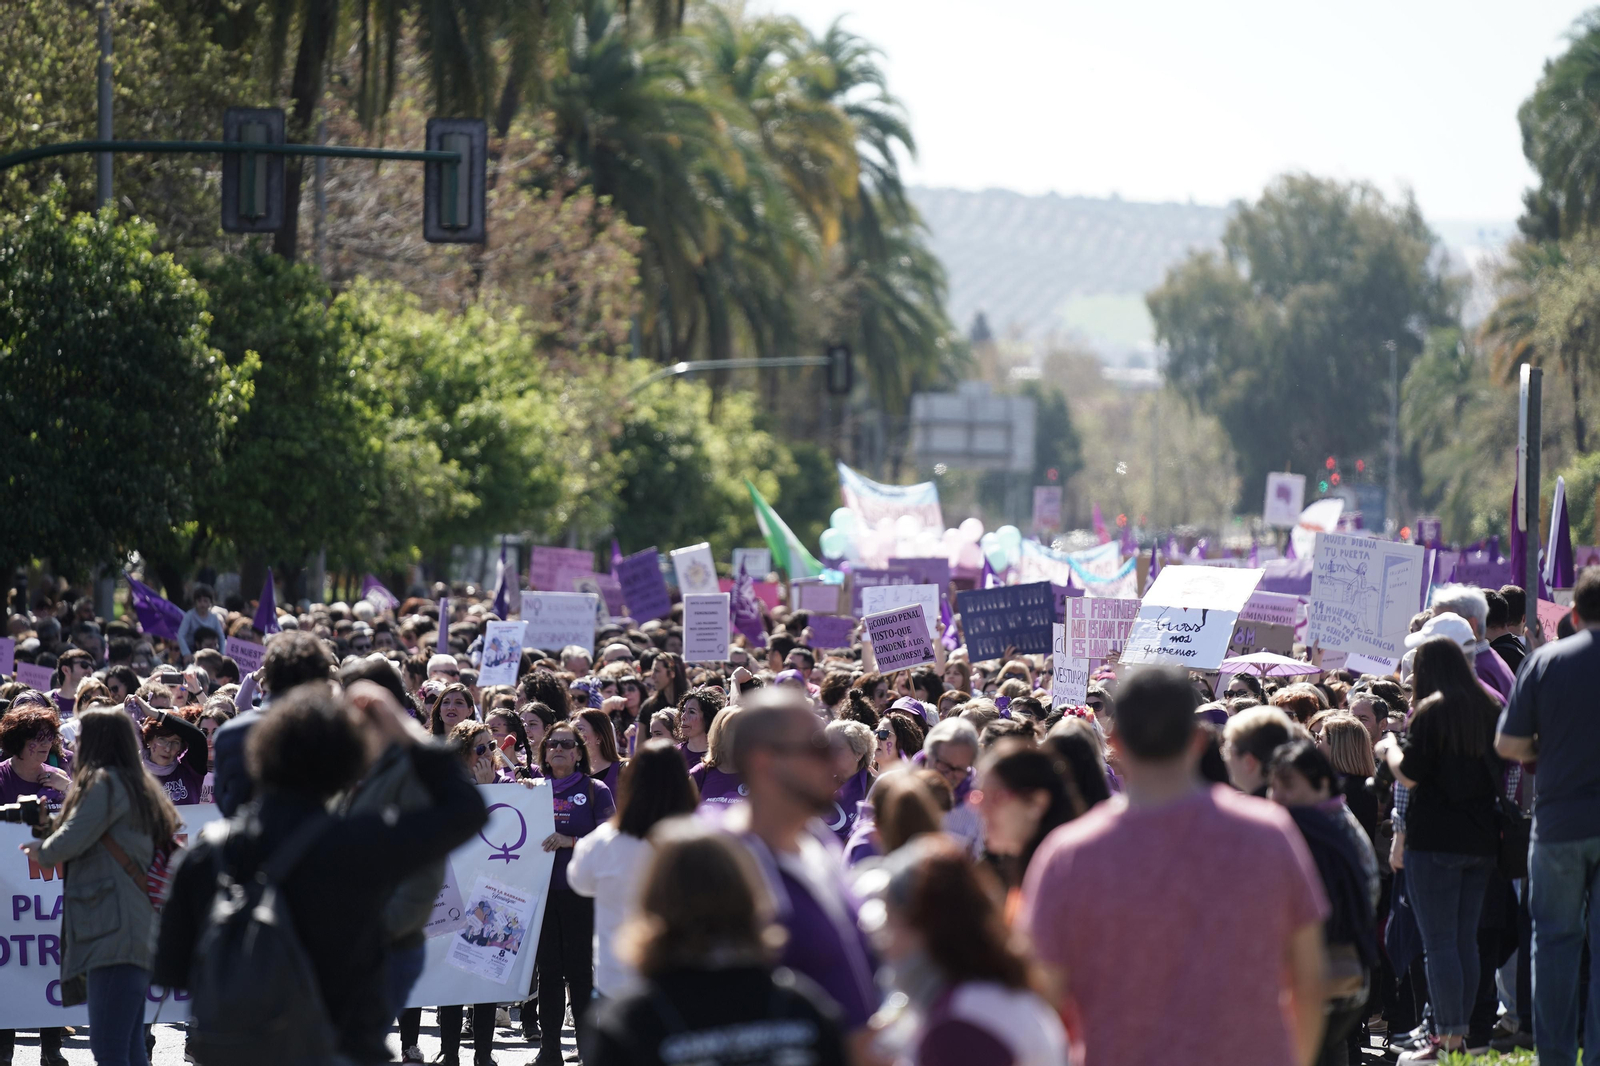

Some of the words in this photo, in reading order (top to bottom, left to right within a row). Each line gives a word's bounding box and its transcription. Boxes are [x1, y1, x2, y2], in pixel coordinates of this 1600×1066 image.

[1323, 534, 1346, 546] MUJER
[1351, 538, 1376, 550] DIBUJA
[1324, 547, 1336, 557] TU
[1340, 549, 1370, 560] PUERTA
[898, 610, 920, 621] PENAL
[1072, 599, 1085, 618] EL
[1071, 620, 1086, 638] NO
[1311, 622, 1322, 630] DE
[871, 626, 912, 644] JUSTO-QUE
[913, 637, 924, 646] LOS
[1169, 635, 1192, 643] nos
[1233, 626, 1256, 646] 8M
[1322, 634, 1341, 646] 2020
[1357, 634, 1395, 652] VIOLENCIA
[231, 644, 239, 652] ES
[1143, 644, 1197, 659] queremos
[877, 649, 922, 665] VIOLADORES!!
[1054, 667, 1087, 686] VESTUARIO
[12, 895, 64, 921] PLA
